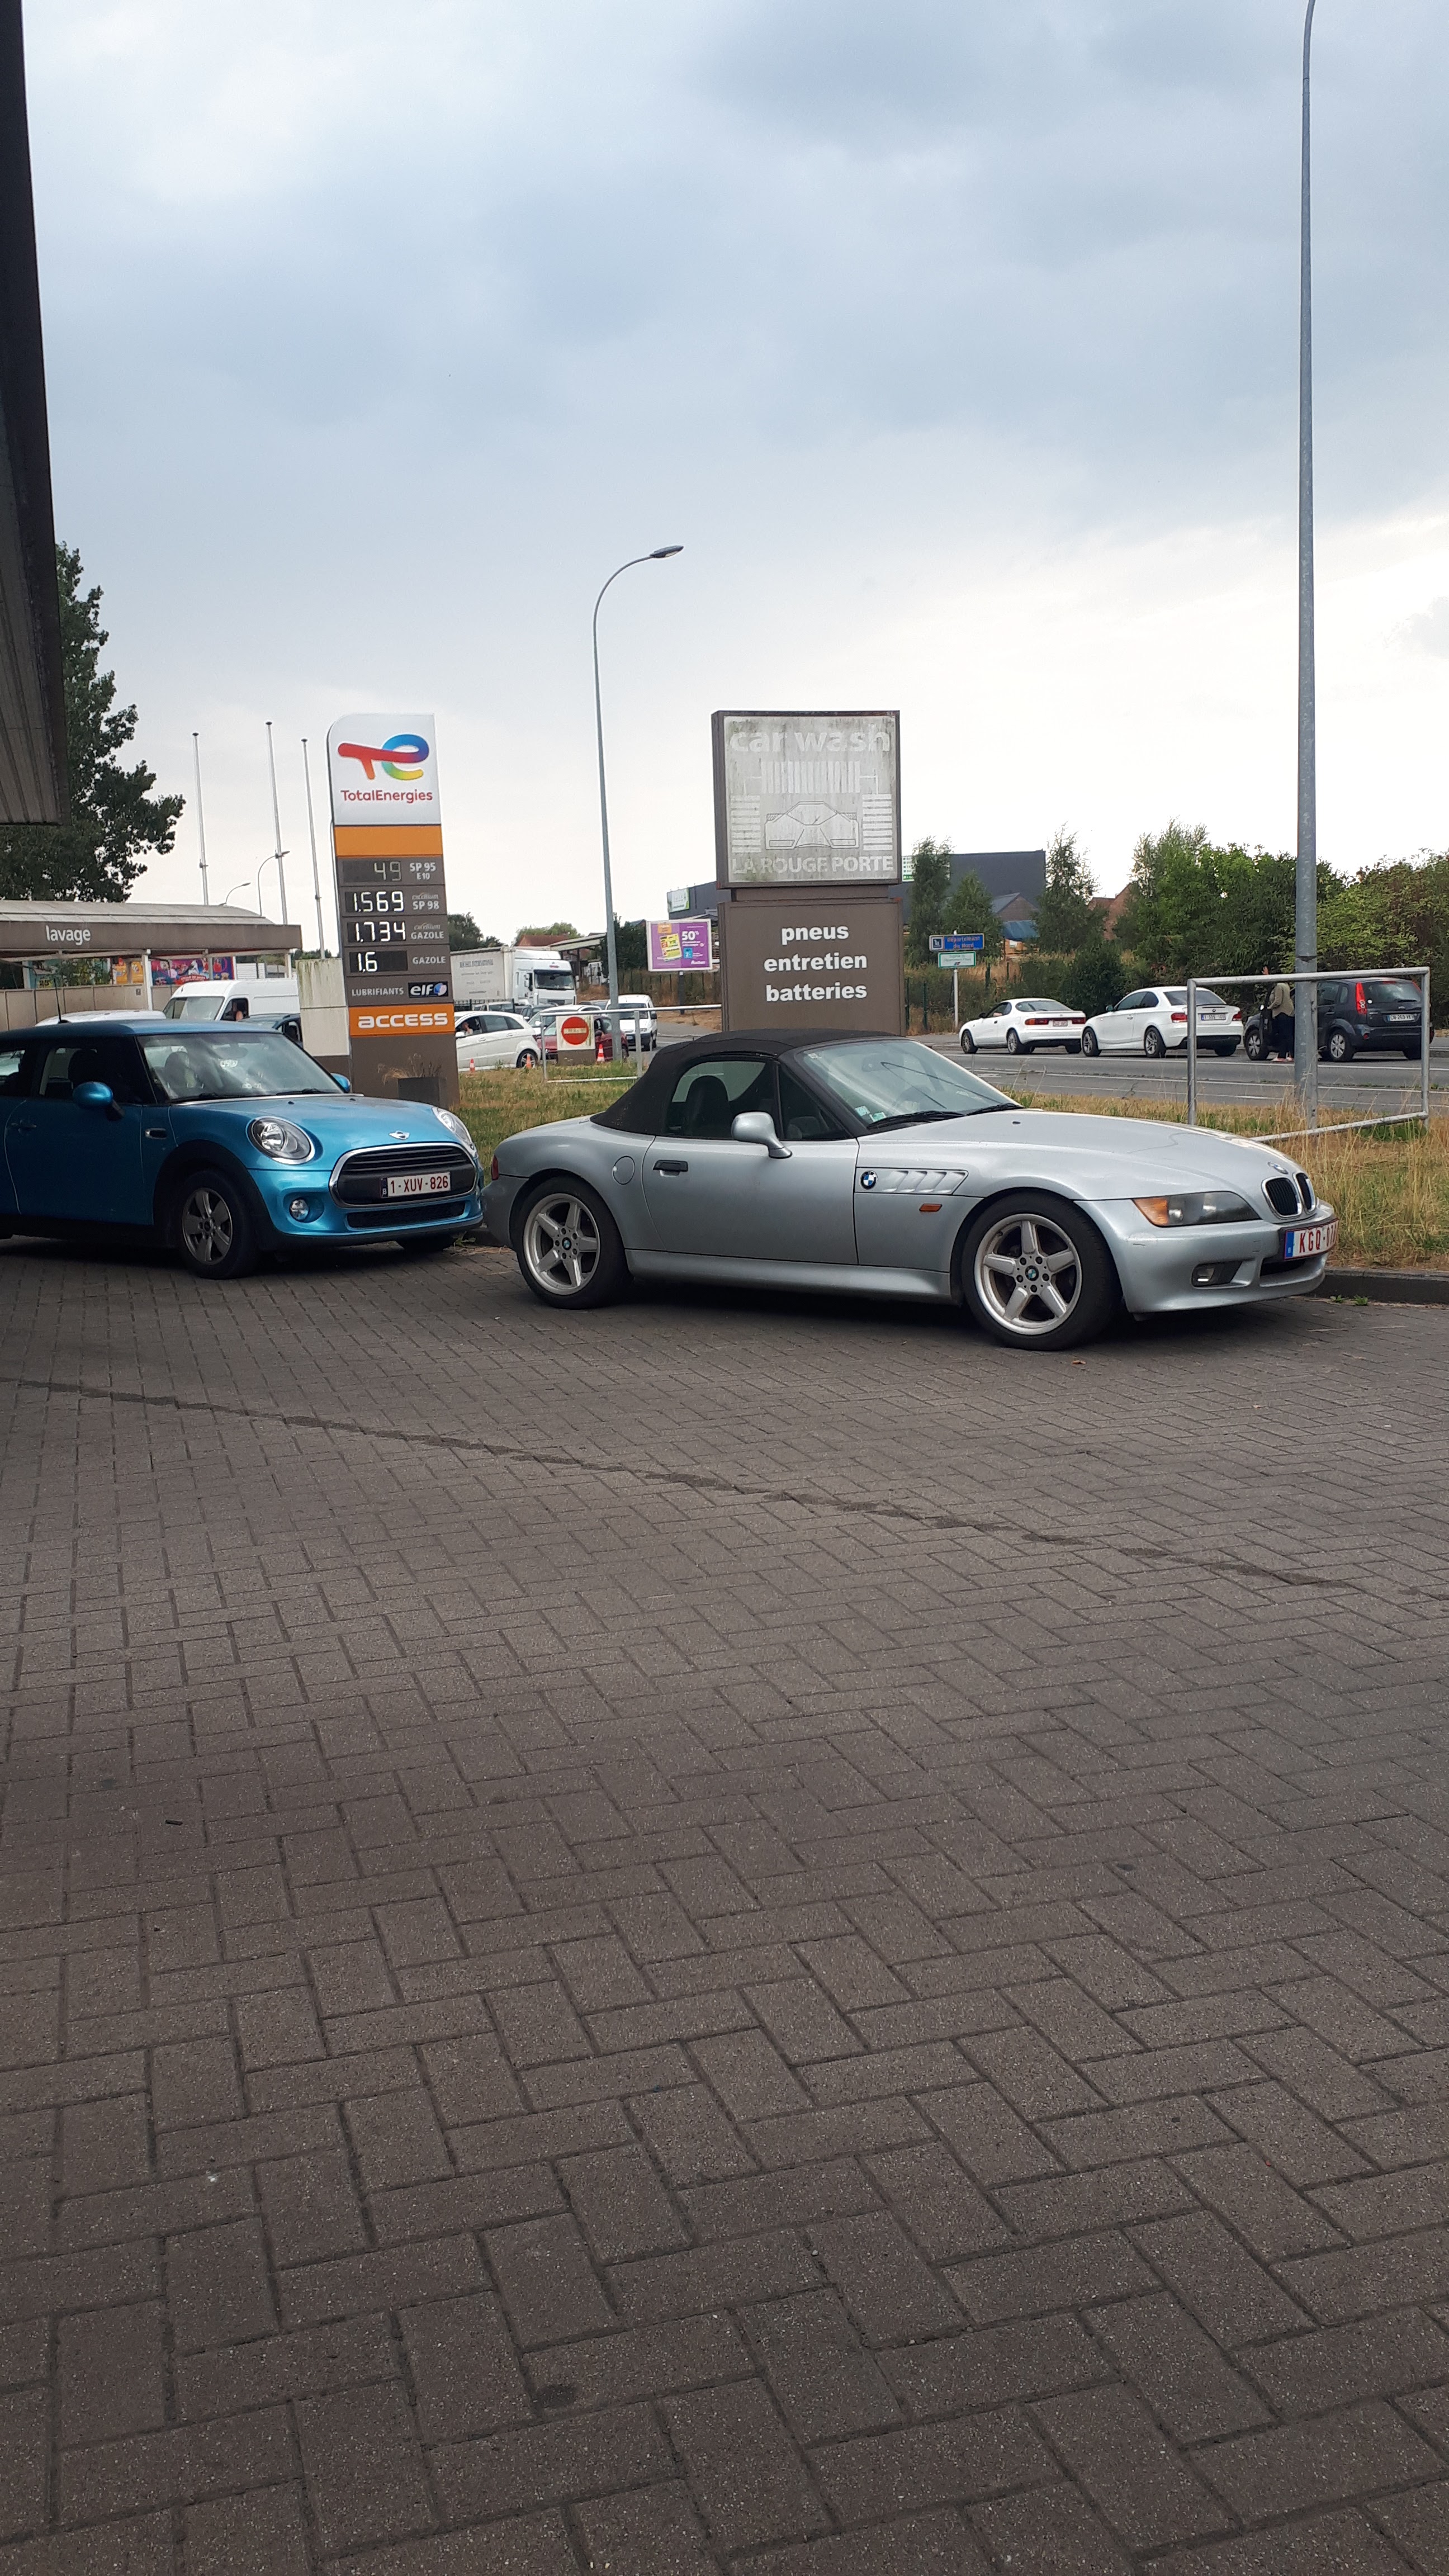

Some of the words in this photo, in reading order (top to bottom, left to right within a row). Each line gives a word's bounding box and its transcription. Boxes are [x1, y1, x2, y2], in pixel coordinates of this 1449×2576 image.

[730, 732, 787, 752] car
[794, 724, 890, 752] wash
[340, 789, 433, 804] TotalEnergies
[409, 862, 422, 872] SP
[424, 862, 436, 872] 95
[732, 858, 755, 874] LA
[760, 856, 827, 873] ROUGE
[831, 855, 893, 872] PORTE
[353, 891, 404, 912] 1.569
[413, 901, 425, 910] SP
[427, 901, 439, 910] 98
[45, 925, 91, 946] lavage
[356, 921, 406, 942] 1.734
[410, 931, 444, 940] GAZOLE
[782, 926, 849, 945] pneus
[412, 956, 446, 965] GAZOLE
[764, 952, 867, 972] entretien
[352, 987, 404, 996] LUBRIFIANTS
[410, 984, 433, 996] elf
[766, 982, 868, 1002] batteries
[390, 1175, 448, 1194] 1-XUV-826
